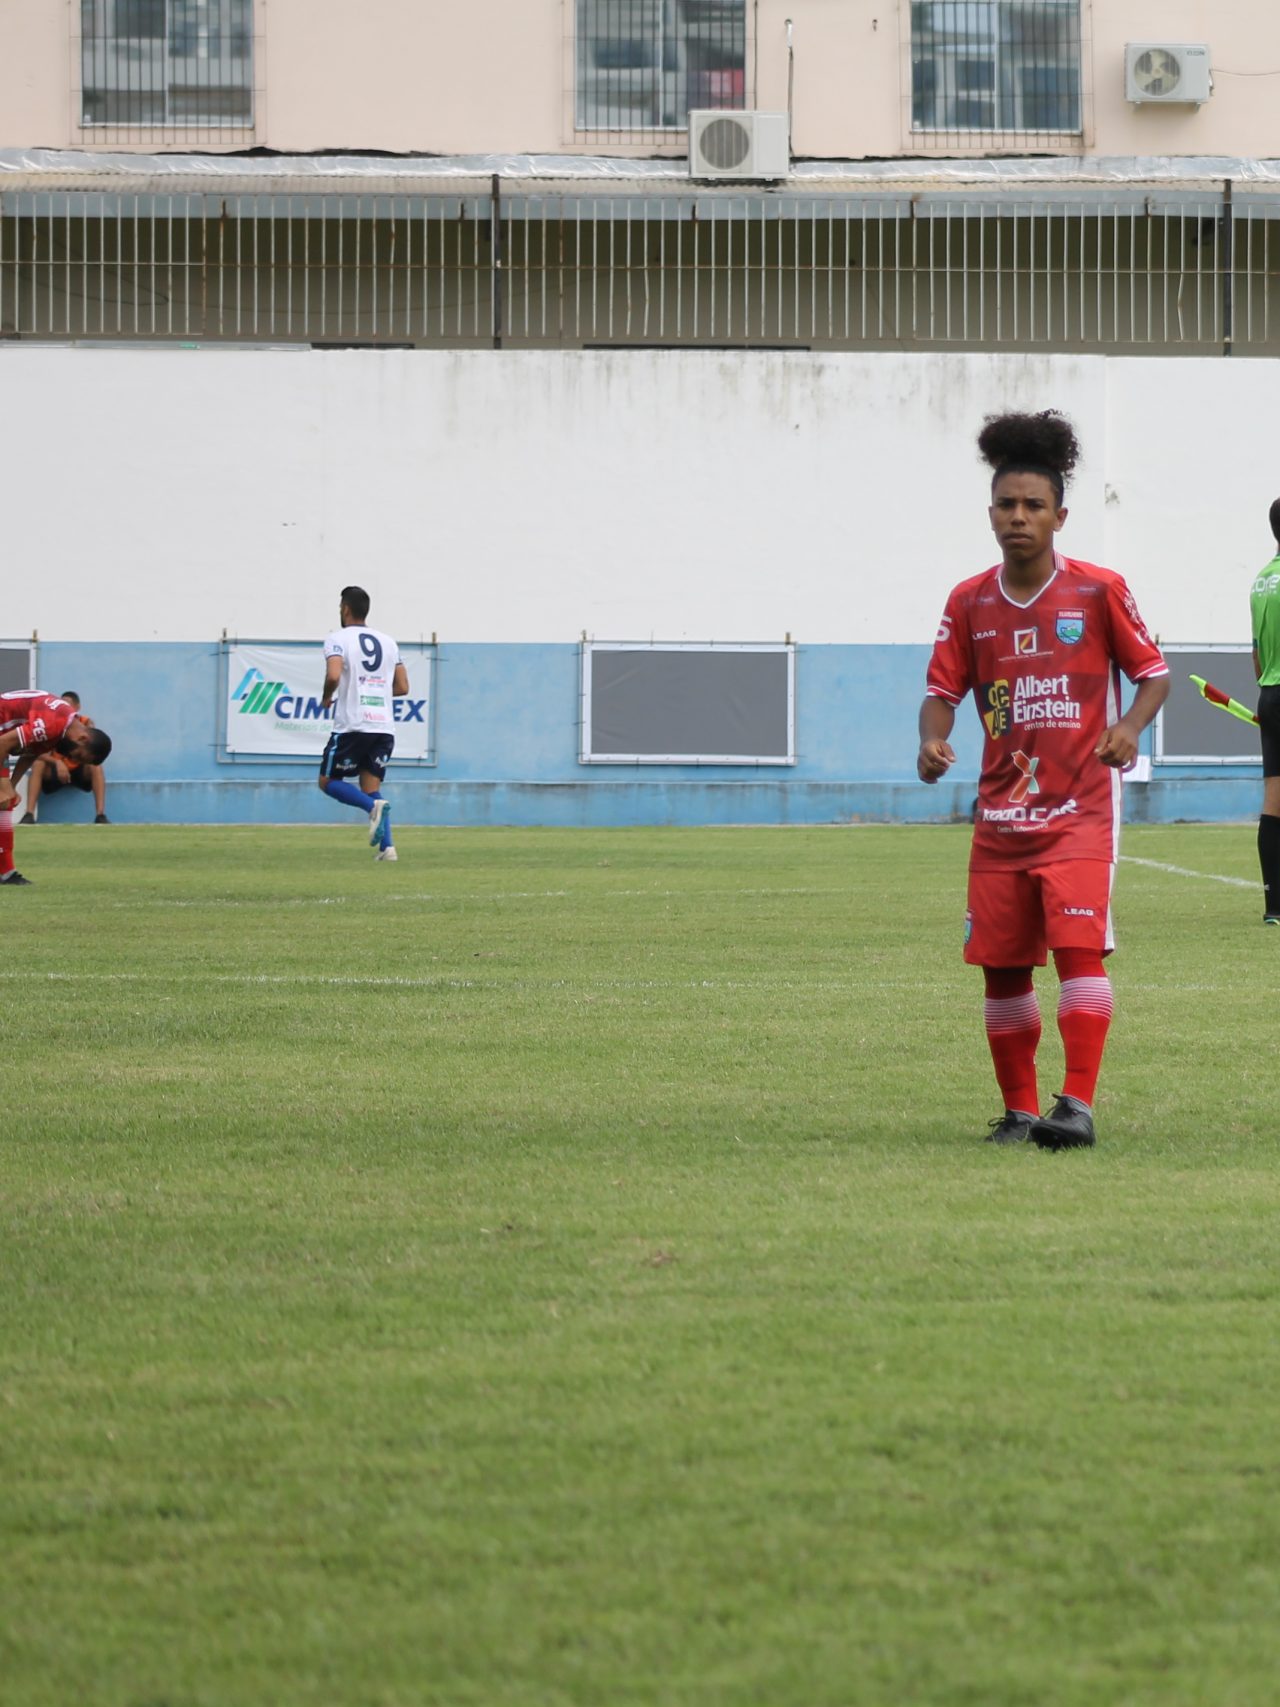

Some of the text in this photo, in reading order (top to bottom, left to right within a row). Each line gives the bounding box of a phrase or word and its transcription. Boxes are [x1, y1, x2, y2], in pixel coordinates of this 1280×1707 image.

[358, 632, 383, 673] 9
[1014, 675, 1069, 701] Albert
[274, 695, 427, 723] CIMEX
[1012, 695, 1081, 724] Einstein
